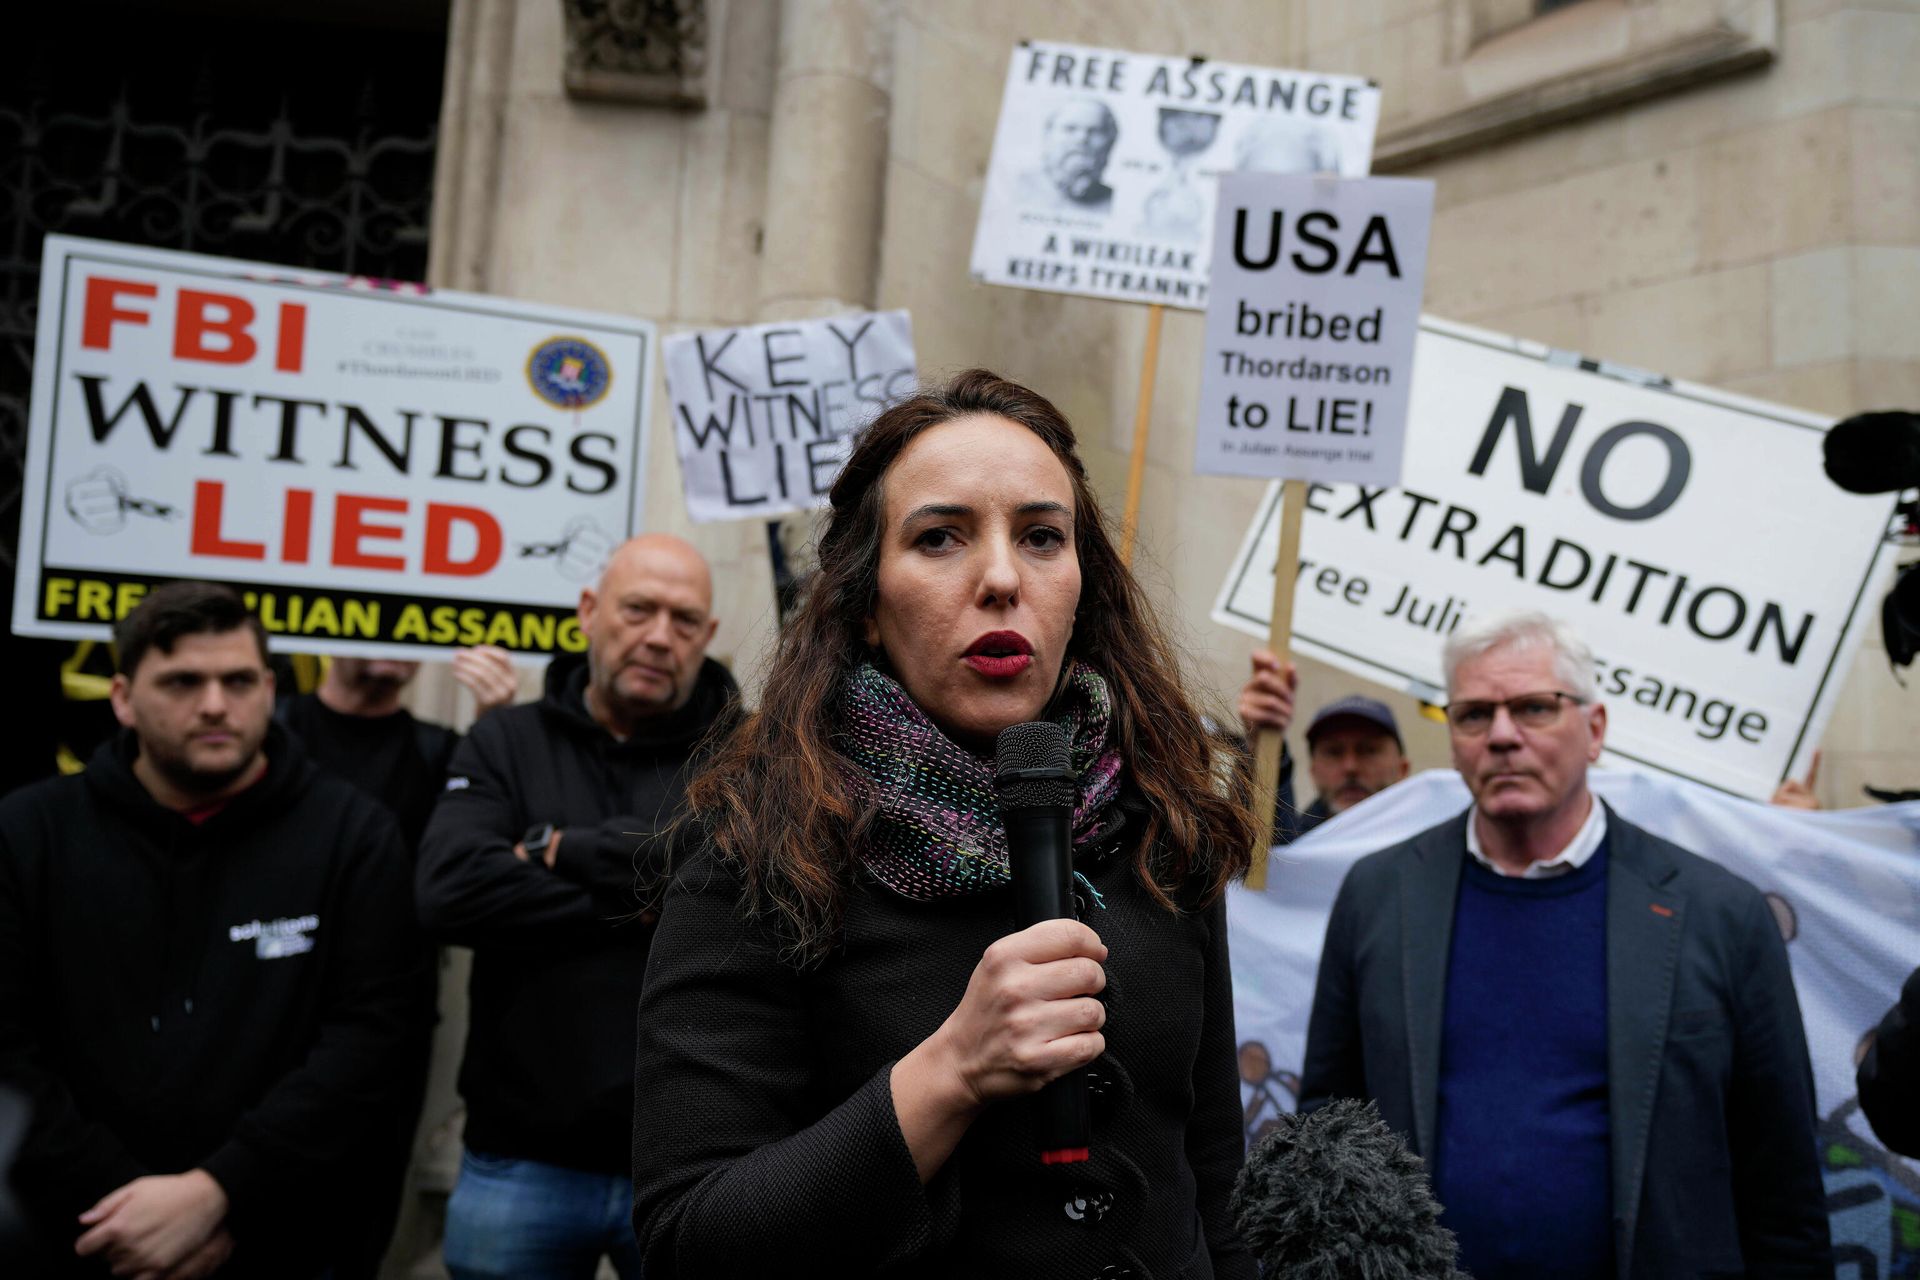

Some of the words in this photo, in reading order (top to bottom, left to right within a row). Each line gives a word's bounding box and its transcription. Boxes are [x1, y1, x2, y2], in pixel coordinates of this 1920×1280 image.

[1024, 51, 1127, 93] FREE
[1144, 64, 1361, 121] ASSANGE
[1006, 257, 1079, 287] KEEPS
[1043, 234, 1058, 253] A
[1233, 207, 1403, 279] USA
[80, 275, 308, 374] FBI
[1235, 299, 1384, 344] bribed
[696, 319, 875, 401] KEY
[1219, 351, 1391, 386] Thordarson
[73, 372, 621, 496] WITNESS
[1226, 394, 1269, 429] to
[1286, 395, 1374, 436] LIE!
[719, 440, 844, 506] LIE
[1466, 385, 1692, 522] NO
[189, 479, 504, 579] LIED
[1271, 557, 1370, 606] ree
[1383, 584, 1467, 634] Juli
[1304, 482, 1814, 666] EXTRADITION
[44, 577, 158, 621] FRE
[243, 590, 381, 639] LIAN
[392, 603, 589, 653] ASSANG
